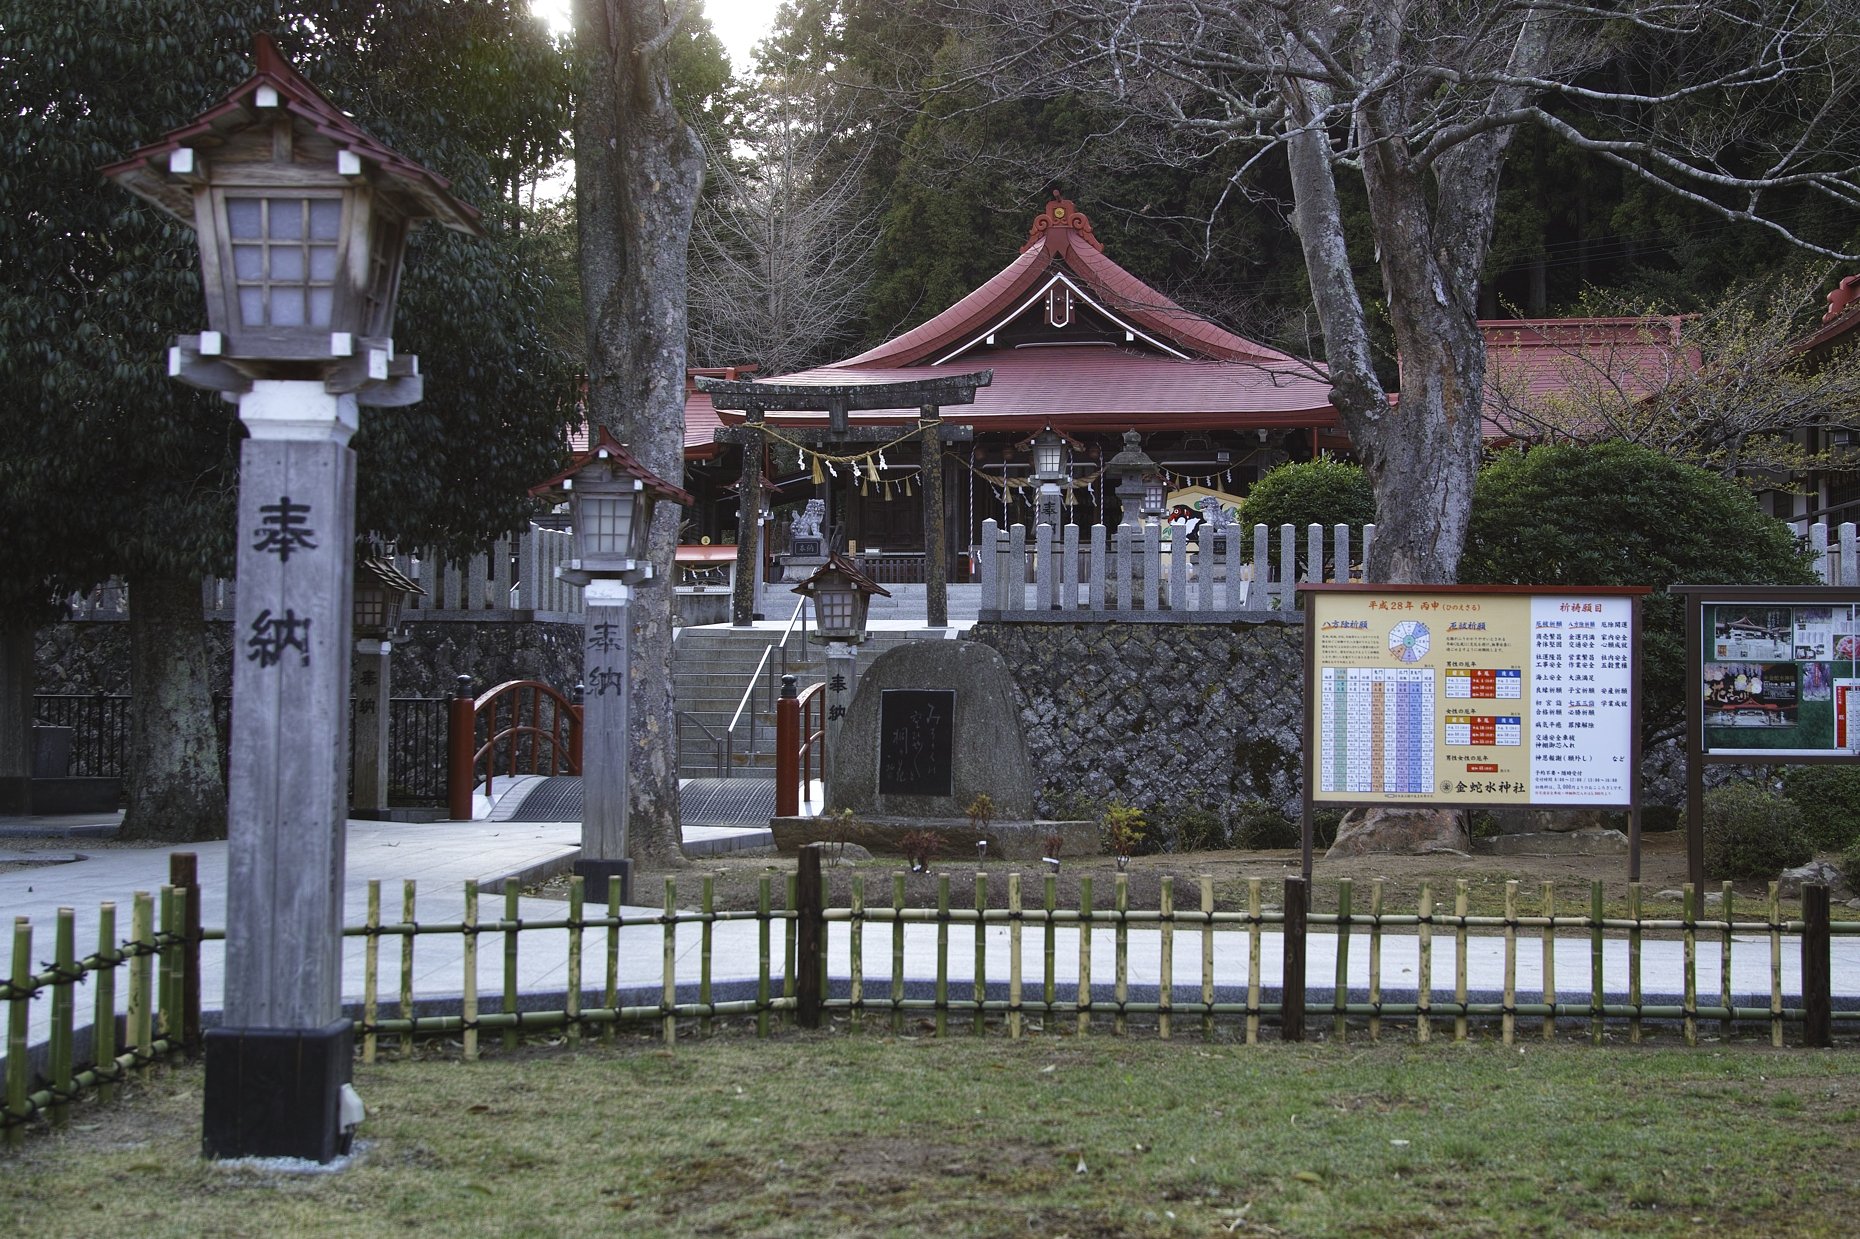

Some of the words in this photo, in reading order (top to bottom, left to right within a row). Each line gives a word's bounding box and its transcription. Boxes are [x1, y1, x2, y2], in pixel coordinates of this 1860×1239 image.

[248, 496, 319, 668] 奉納
[1322, 620, 1368, 629] 八方除祈願
[1368, 600, 1414, 610] 平成28年
[586, 621, 625, 699] 奉納
[359, 669, 377, 714] 奉納
[828, 674, 847, 721] 奉納
[1455, 781, 1525, 793] 金蛇水神社
